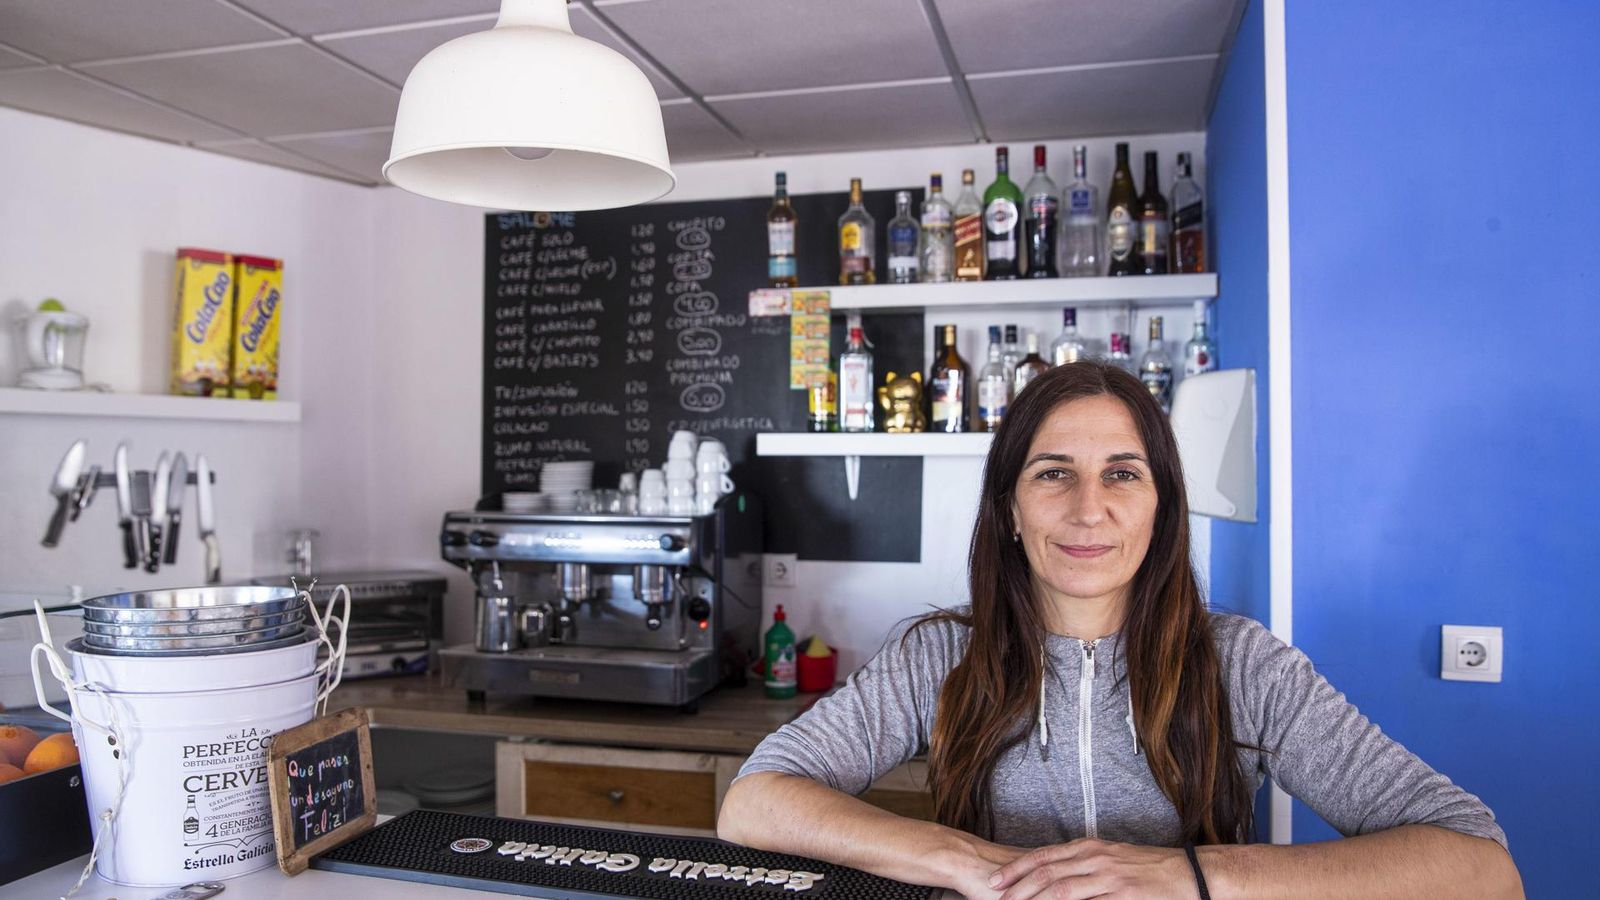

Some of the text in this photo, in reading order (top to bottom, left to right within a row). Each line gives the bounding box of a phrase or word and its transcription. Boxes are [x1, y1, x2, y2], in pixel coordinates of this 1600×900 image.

[242, 728, 257, 738] LA
[183, 758, 227, 768] OBTENIDA
[288, 759, 315, 779] Que
[205, 824, 219, 838] 4
[183, 843, 274, 870] Estrella Galicia
[498, 840, 640, 874] Galicia
[648, 857, 824, 891] Estrella
